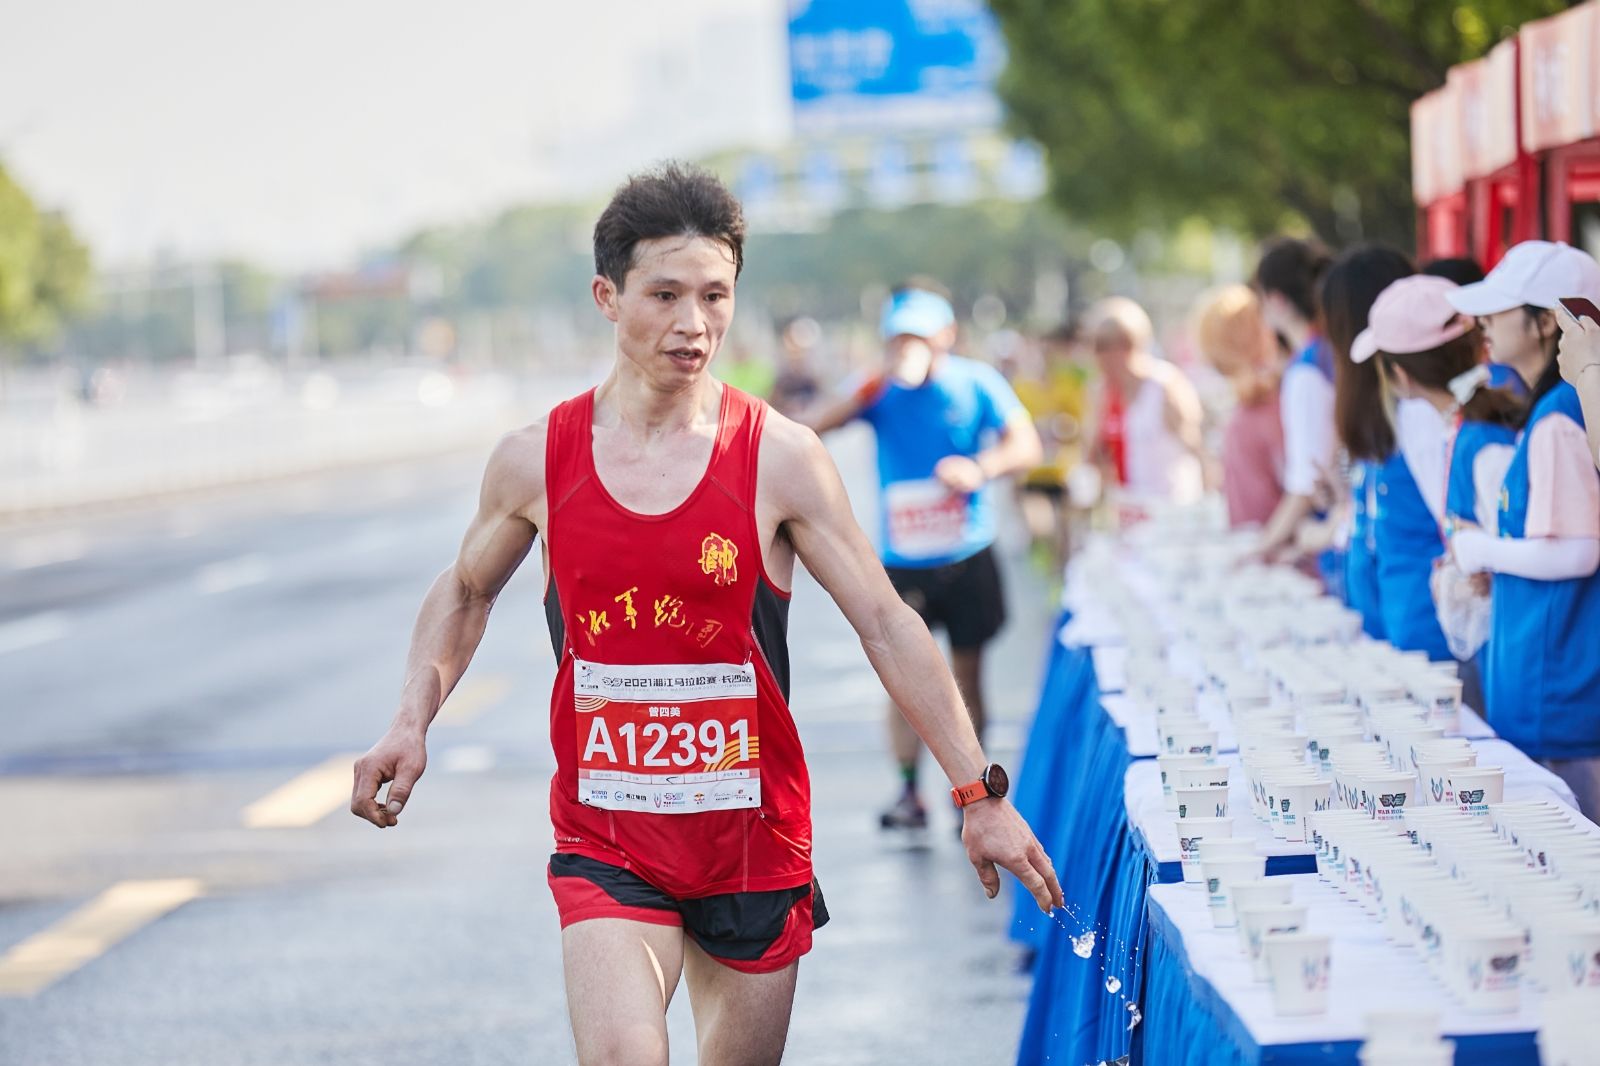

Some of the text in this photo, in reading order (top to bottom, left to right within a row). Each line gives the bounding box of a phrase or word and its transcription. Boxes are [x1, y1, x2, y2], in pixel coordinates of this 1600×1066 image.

[649, 706, 681, 717] 曾四美
[582, 716, 749, 767] A12391
